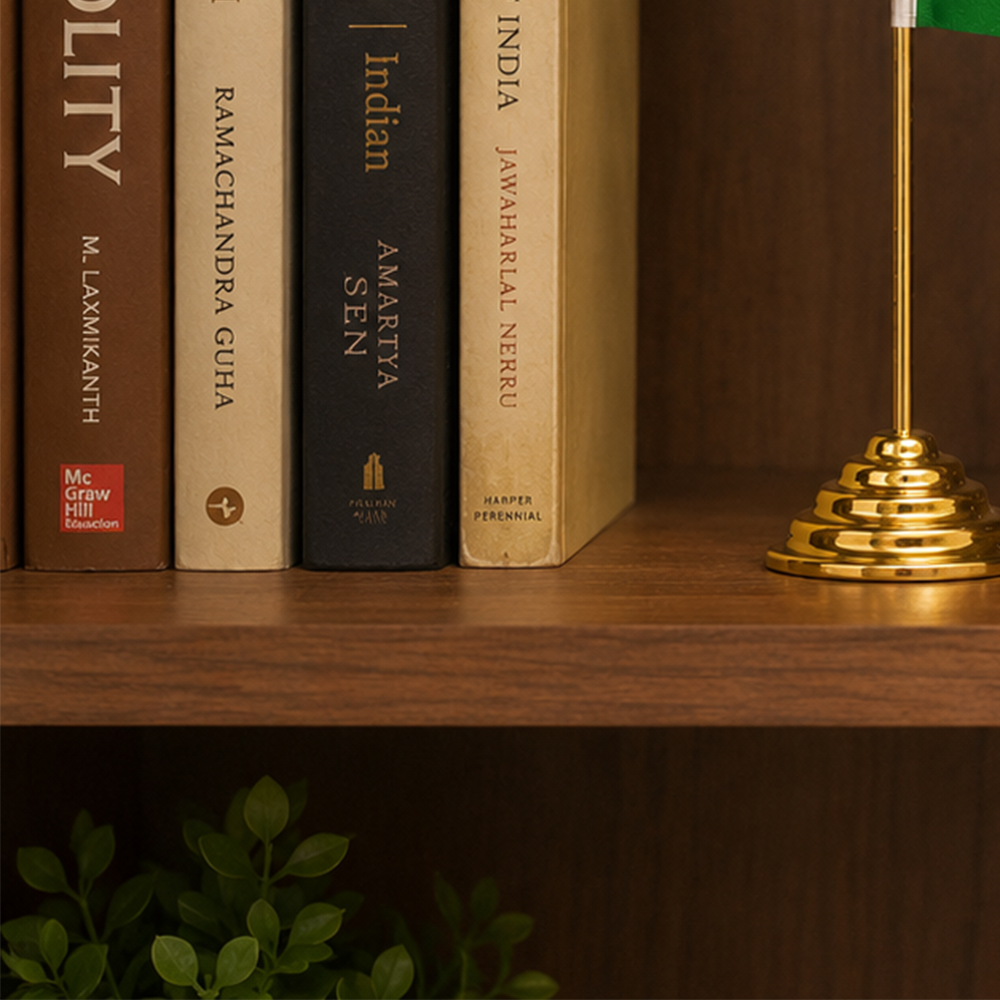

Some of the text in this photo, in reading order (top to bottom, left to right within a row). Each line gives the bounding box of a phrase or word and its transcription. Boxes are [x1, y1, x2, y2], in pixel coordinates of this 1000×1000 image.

[497, 14, 521, 111] INDIA
[364, 52, 401, 173] Indian
[213, 86, 235, 411] RAMACHANDRA GUHA
[494, 146, 518, 312] JAWAHARLAL
[81, 235, 100, 423] M. LAXMIKANTH
[343, 275, 368, 356] SEN
[376, 239, 400, 390] AMARTYA
[64, 467, 92, 486] Mc
[64, 485, 111, 501] Graw
[64, 501, 93, 518] Hill
[473, 510, 543, 522] PERENNIAL
